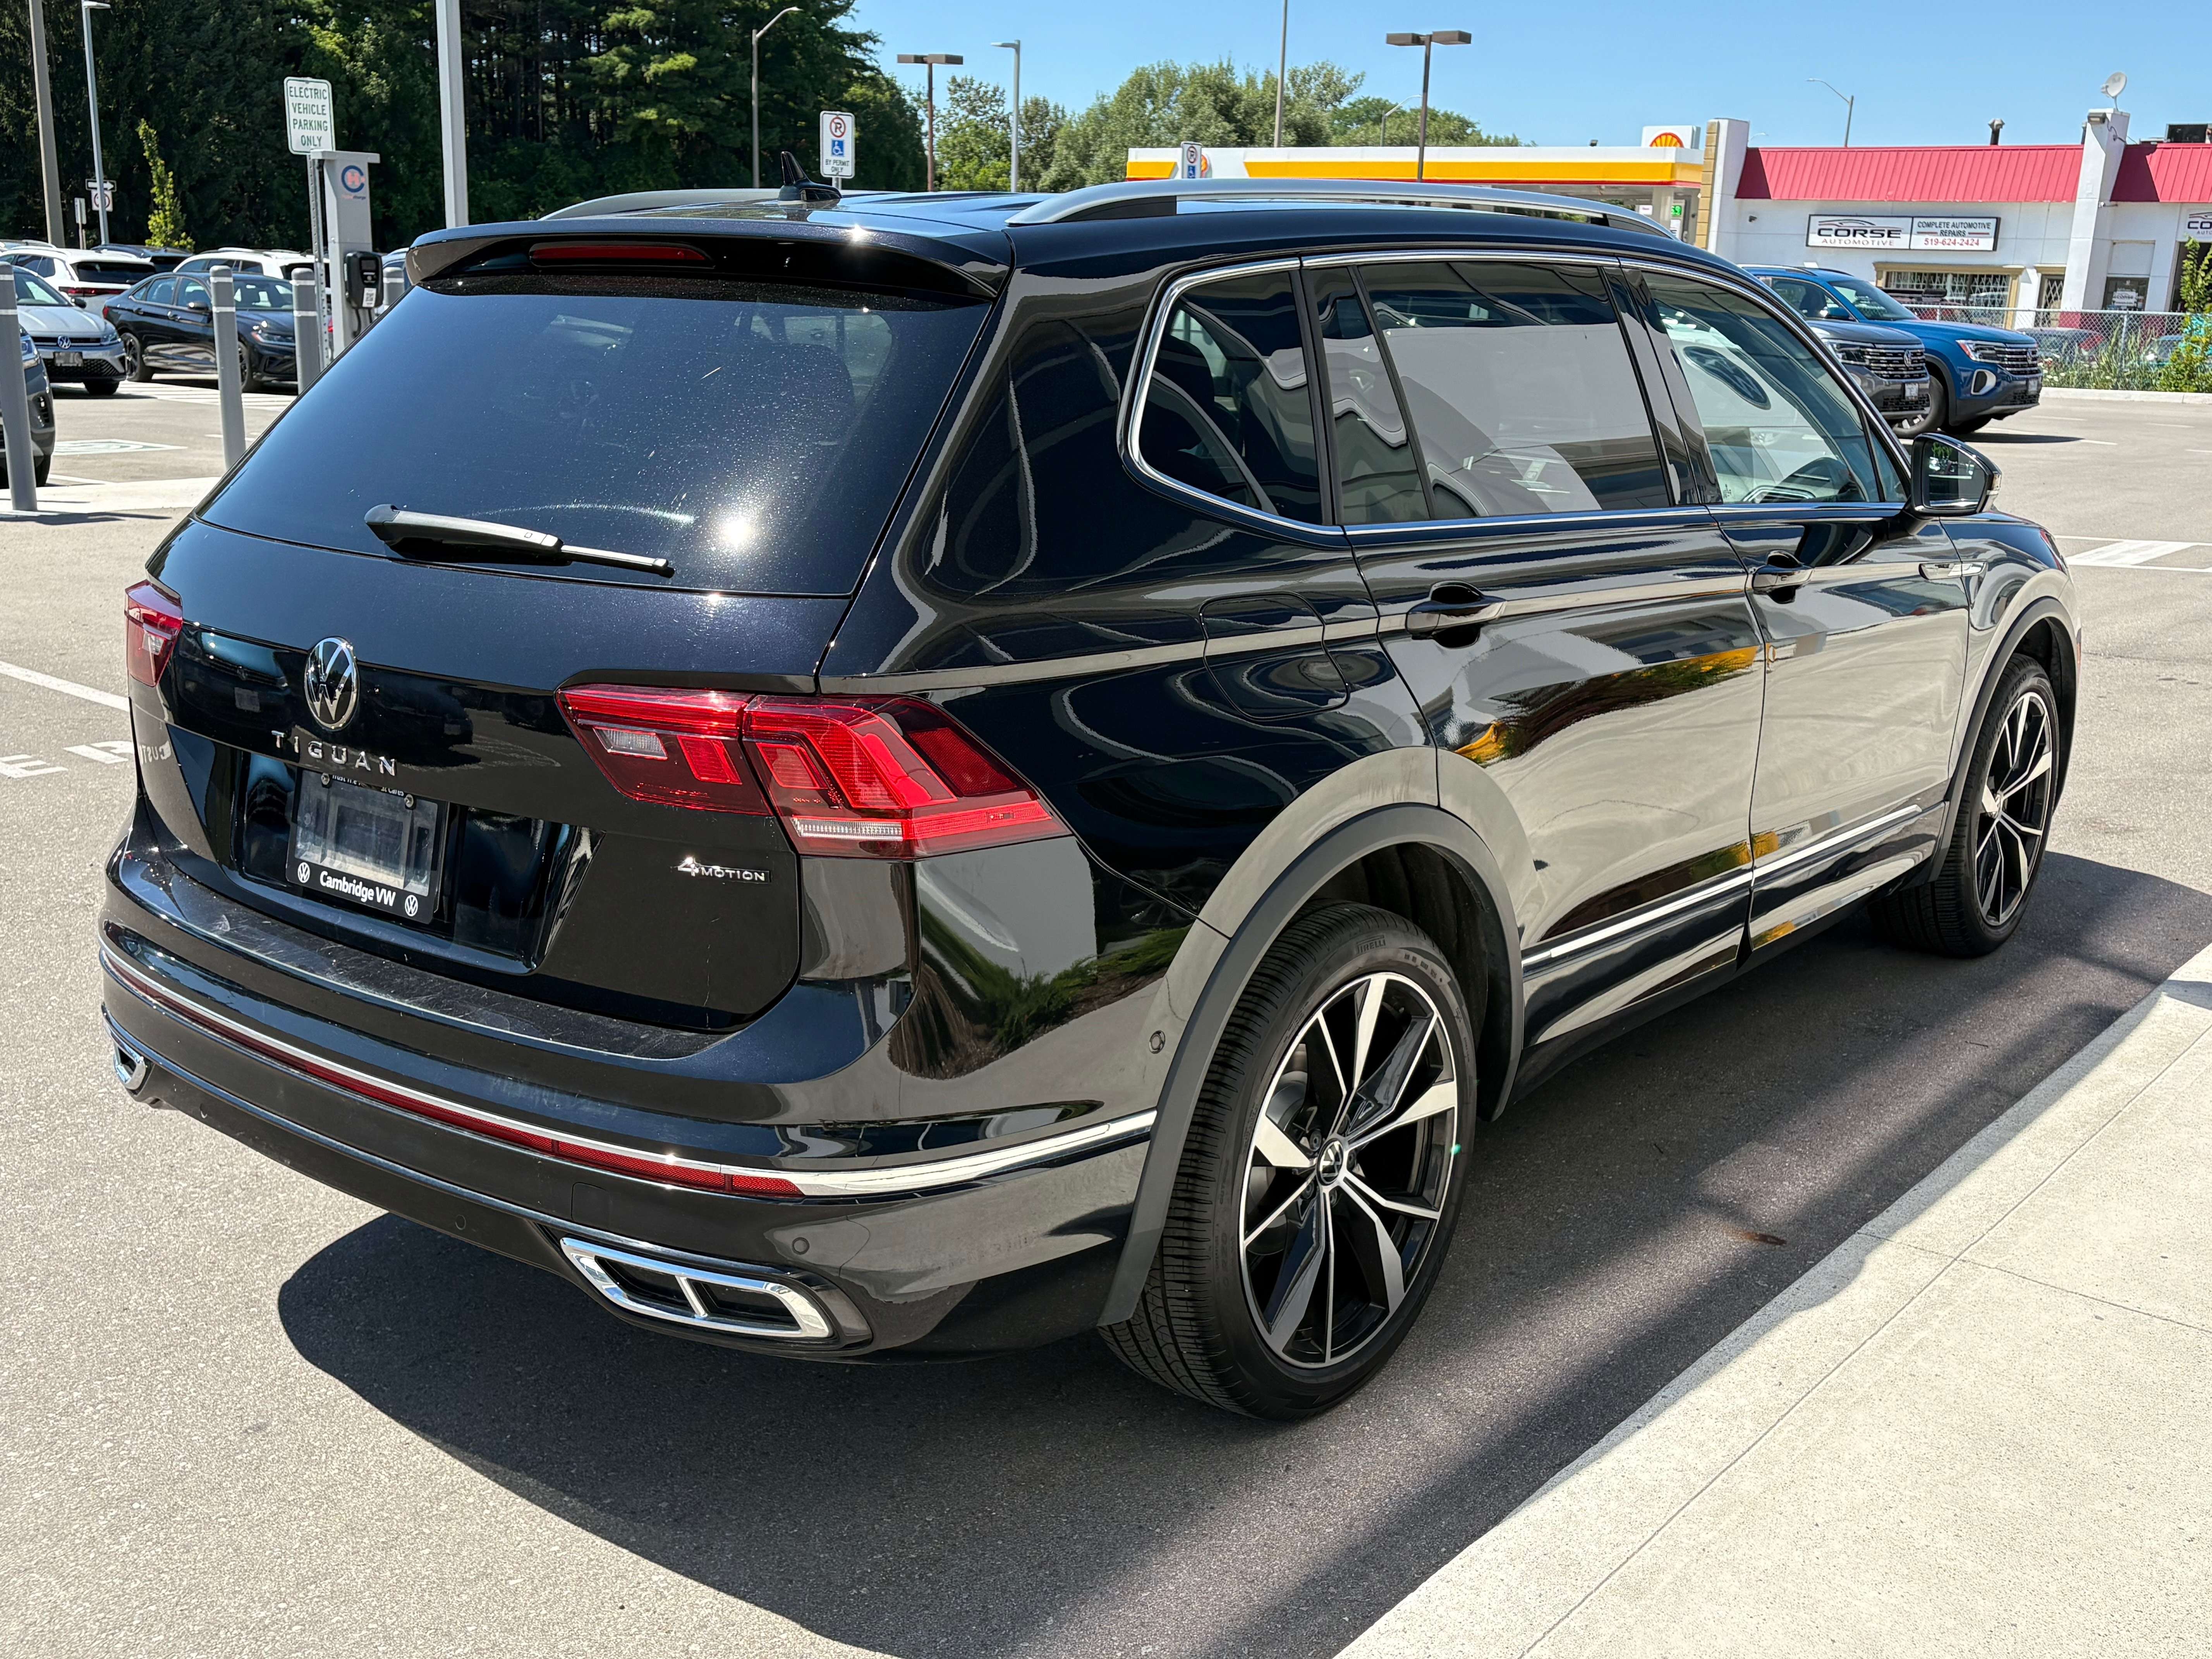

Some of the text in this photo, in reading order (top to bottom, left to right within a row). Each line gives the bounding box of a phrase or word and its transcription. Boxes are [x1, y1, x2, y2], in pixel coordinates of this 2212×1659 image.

[289, 86, 327, 100] ELECTRIC
[292, 103, 326, 115] VEHICLE
[293, 118, 328, 131] PARKING
[301, 135, 322, 147] ONLY
[1817, 228, 1902, 239] CORSE
[1924, 238, 1979, 246] 519-624-2424
[271, 730, 395, 776] TIGUAN
[320, 871, 396, 907] Cambridge VW
[1357, 934, 1386, 954] PIRELLI
